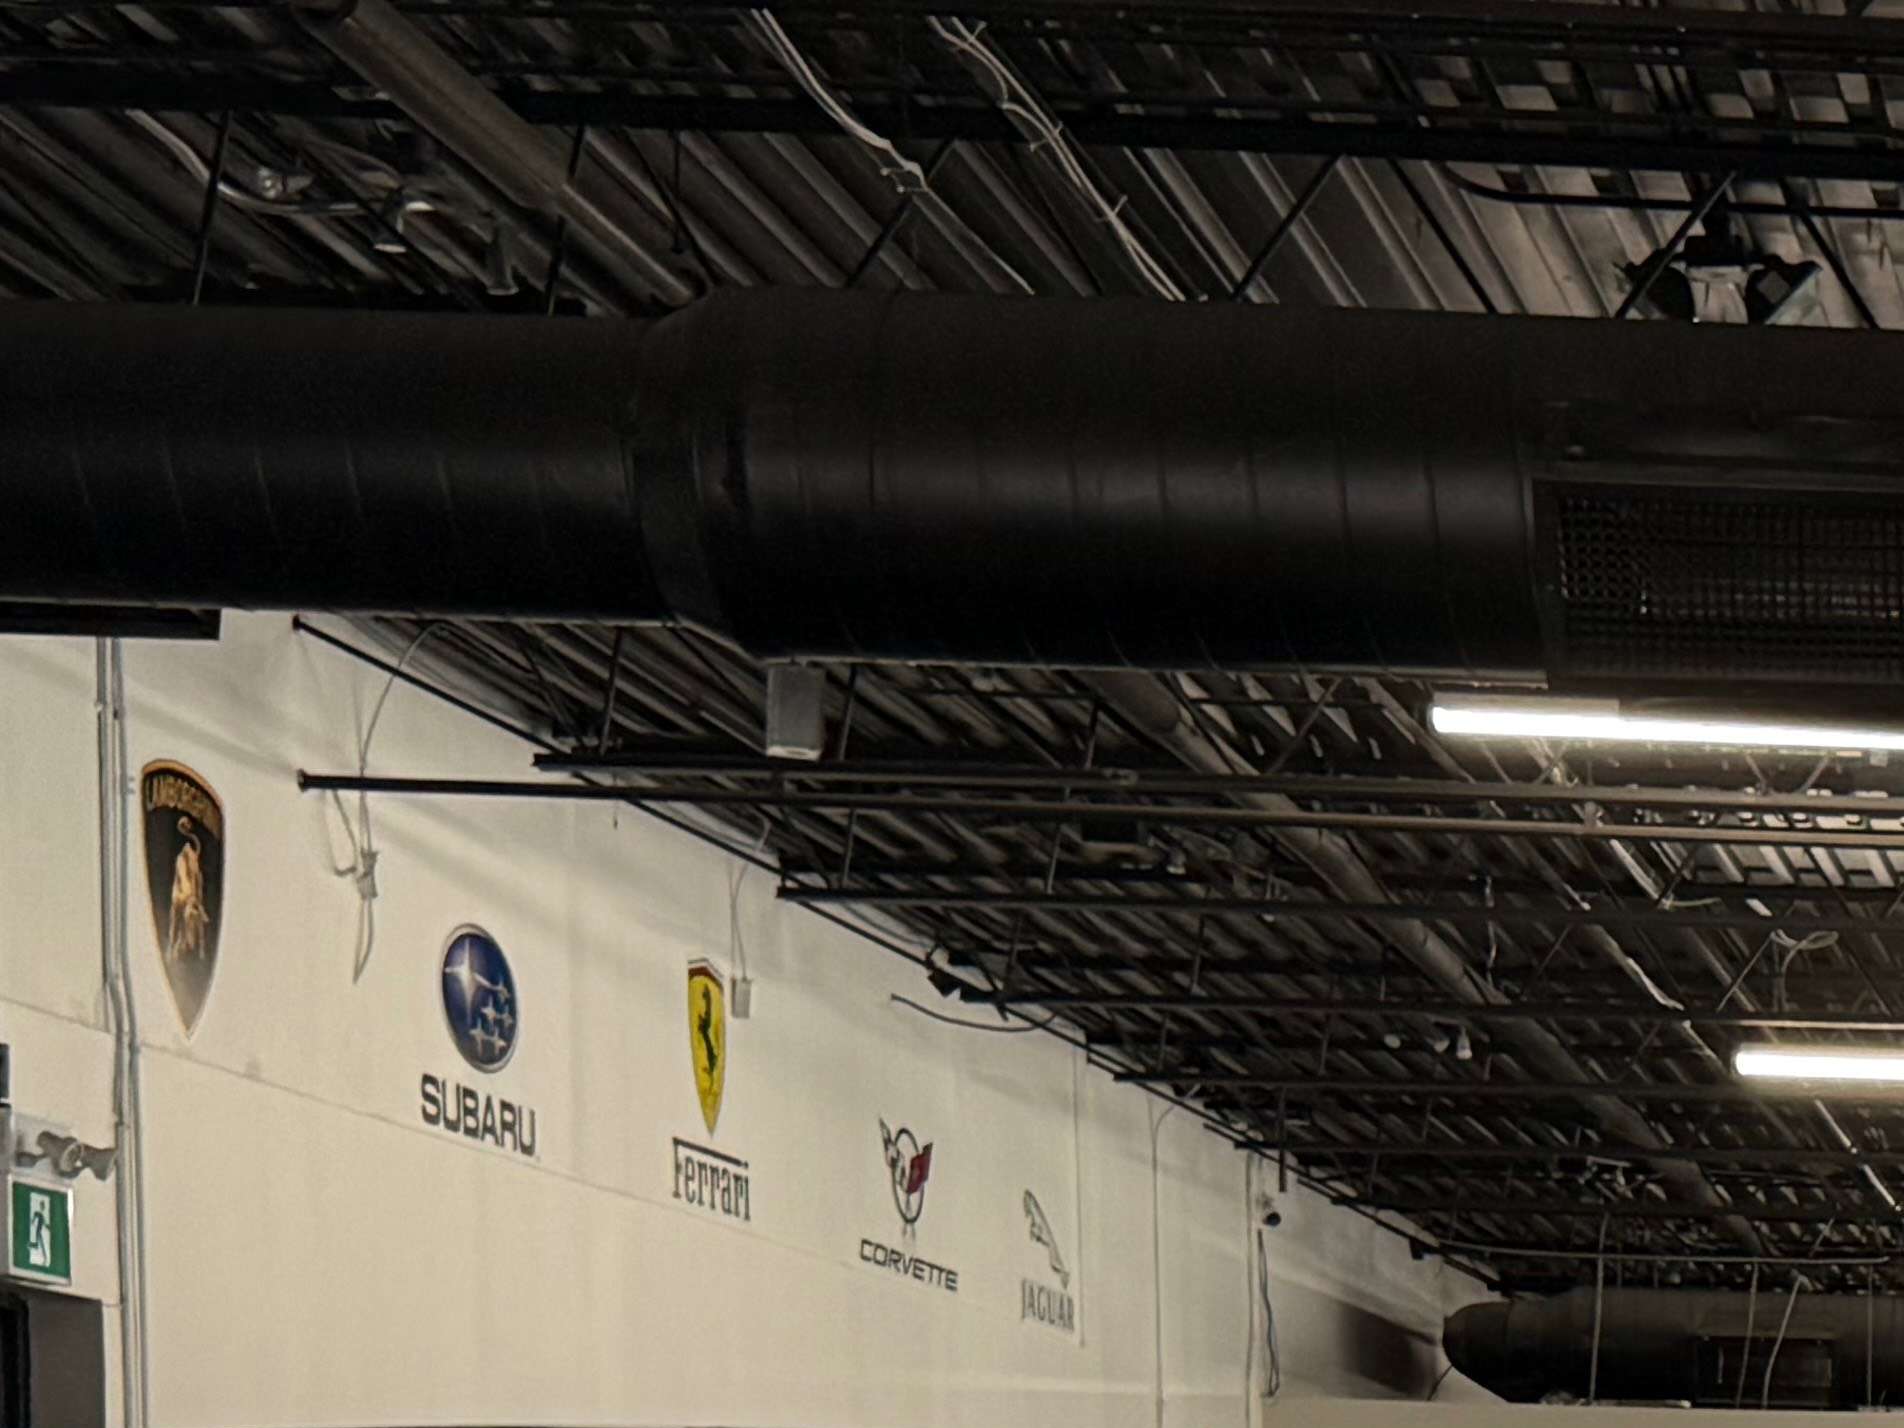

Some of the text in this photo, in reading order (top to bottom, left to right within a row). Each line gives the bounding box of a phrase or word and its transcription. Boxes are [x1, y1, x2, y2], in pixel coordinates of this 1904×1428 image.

[421, 1072, 536, 1157] SUBARU
[672, 1136, 750, 1221] Ferrari
[860, 1238, 958, 1292] CORVETTE
[1021, 1278, 1075, 1331] JAGUAR
